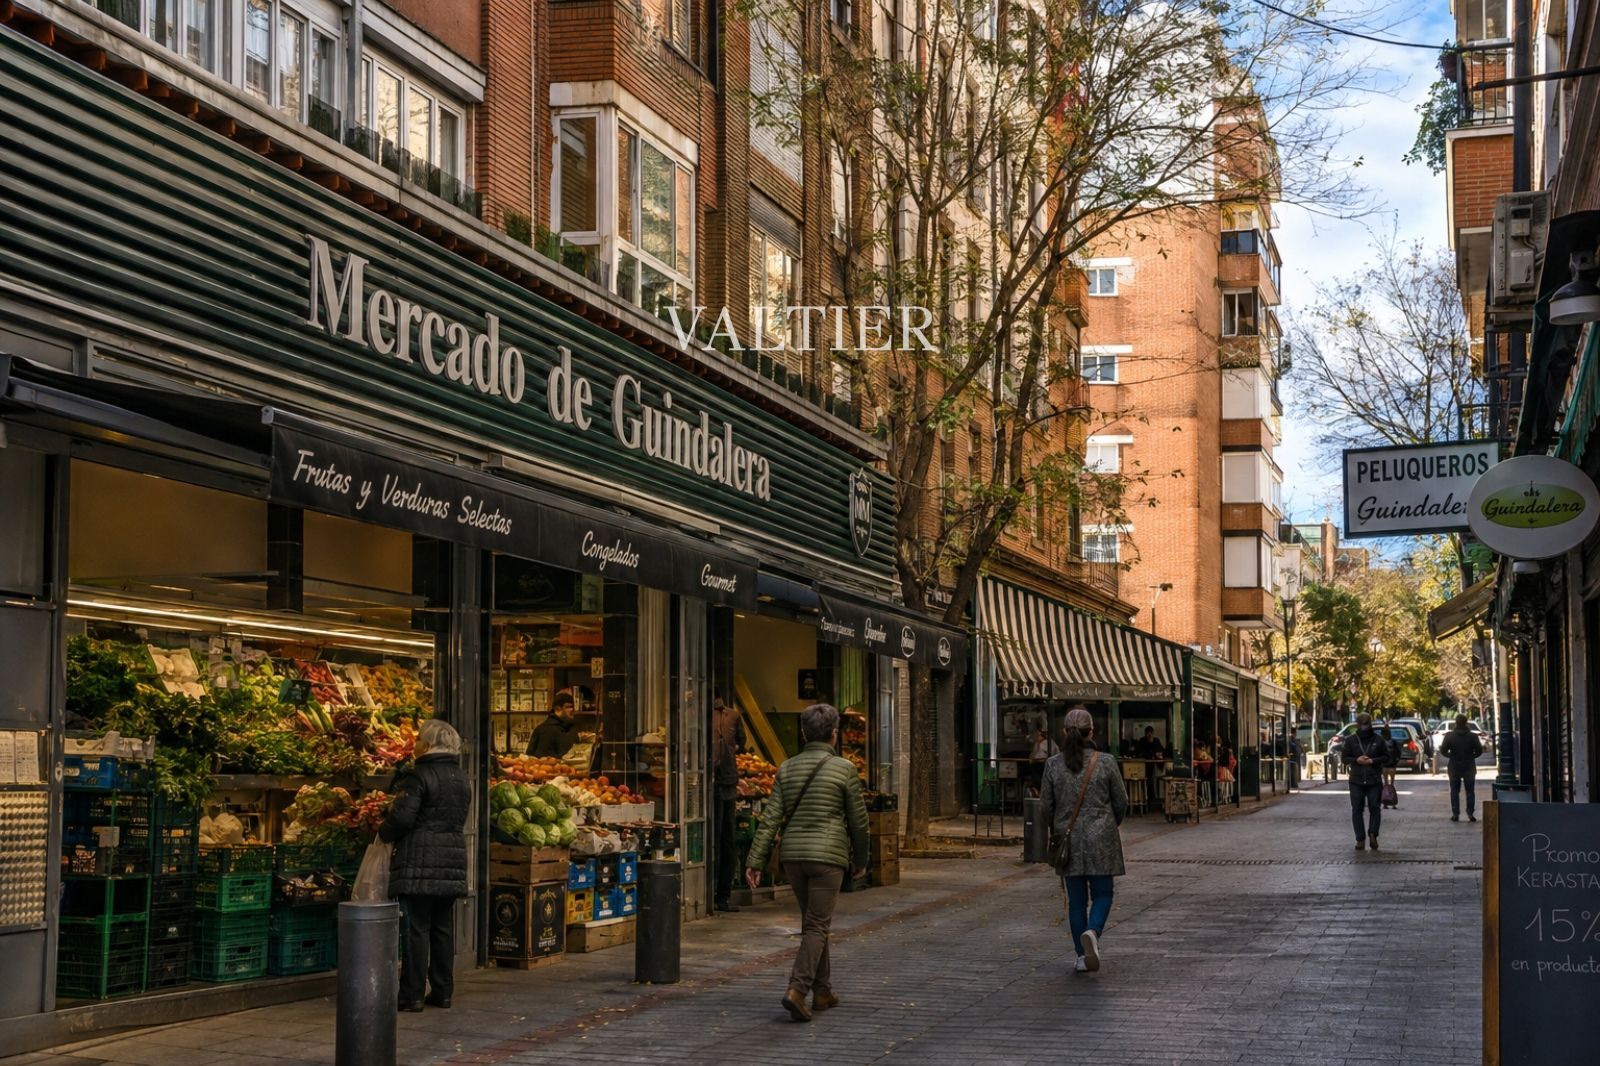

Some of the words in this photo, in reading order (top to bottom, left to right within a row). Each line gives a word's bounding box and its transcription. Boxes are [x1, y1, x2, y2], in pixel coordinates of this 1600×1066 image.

[303, 233, 526, 404] Mercado
[547, 345, 592, 431] de
[611, 374, 771, 502] Guindalera
[1357, 452, 1489, 484] PELUQUEROS
[293, 449, 352, 494] Frutas
[356, 480, 371, 510] y
[381, 474, 450, 519] Verduras
[457, 495, 512, 535] Selectas
[1357, 492, 1467, 526] Guindale
[1485, 496, 1582, 521] Guindalera
[581, 530, 640, 571] Congelados
[701, 563, 737, 593] Gourmet
[1522, 832, 1600, 864] Promo
[1517, 865, 1600, 889] KERASTA
[1525, 907, 1600, 942] 15%
[1511, 959, 1529, 971] en
